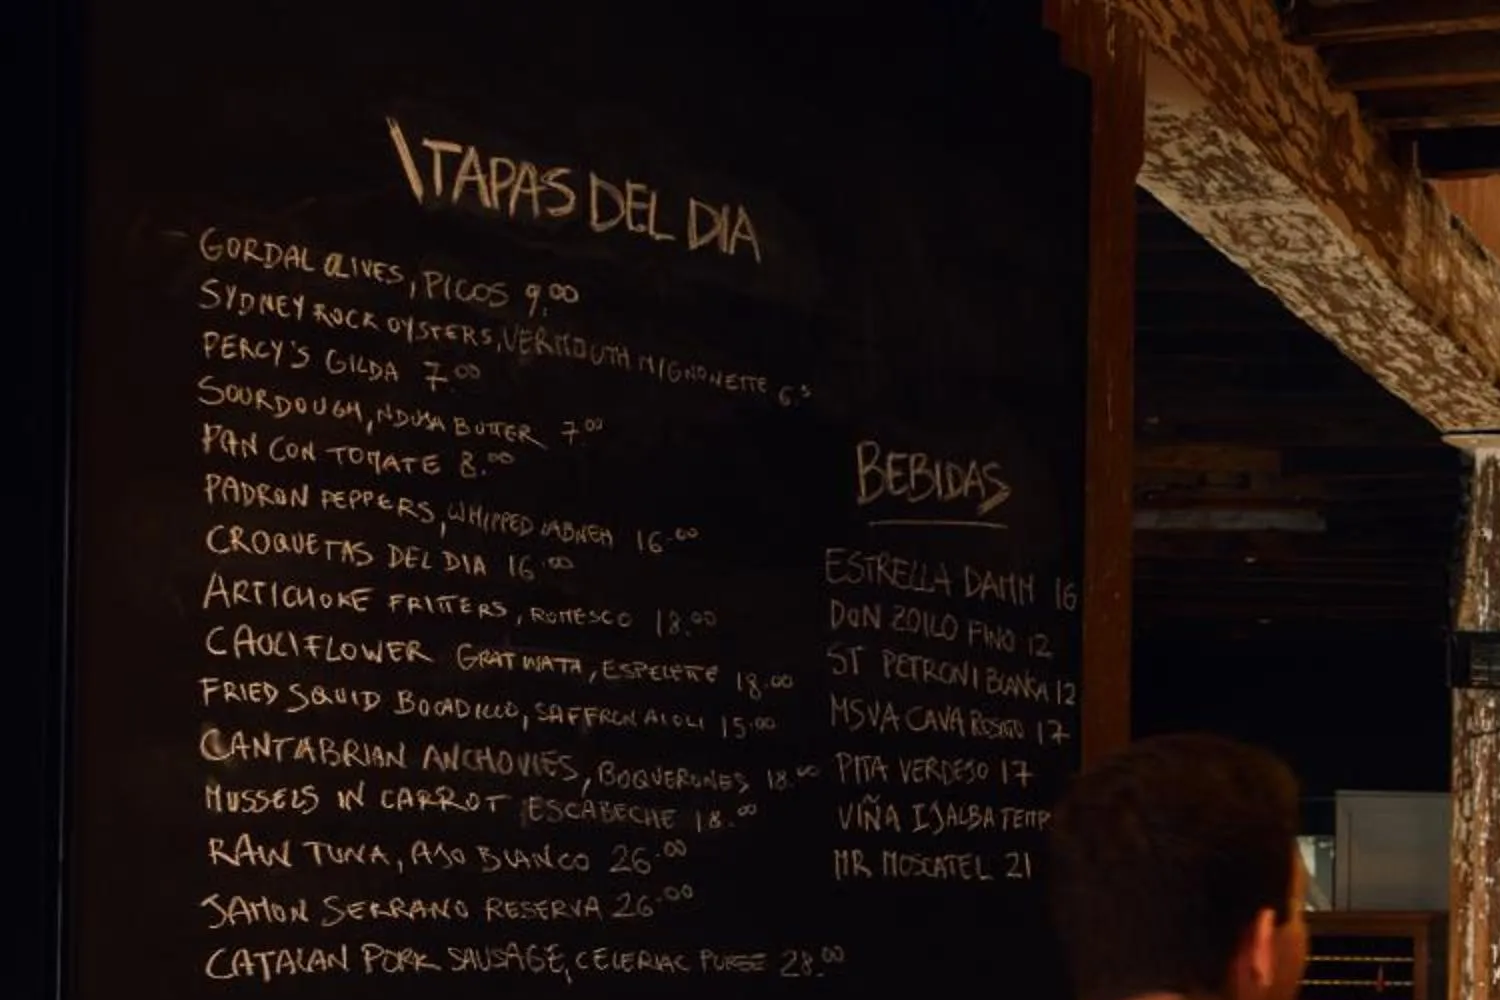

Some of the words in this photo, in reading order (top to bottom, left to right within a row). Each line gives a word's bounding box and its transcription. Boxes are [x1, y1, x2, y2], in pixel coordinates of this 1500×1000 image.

[588, 170, 676, 241] DEL
[688, 197, 762, 264] DIA
[199, 227, 316, 273] GORDAL
[422, 270, 510, 308] PICOS
[199, 278, 306, 321] SYDNEY
[312, 303, 381, 331] ROCK
[503, 327, 631, 371] VERMOUTH
[202, 331, 310, 369] PERCY'S
[325, 349, 399, 383] GILDA
[202, 422, 258, 457] PAN
[269, 435, 317, 463] CON
[325, 446, 441, 475] TOMATE
[453, 416, 549, 450] BUTTER
[856, 440, 1012, 516] BEBIDAS
[203, 473, 309, 508] PADRON
[448, 500, 534, 538] WHIPPED
[206, 524, 375, 568] CROQUETAS
[387, 543, 433, 570] DEL
[441, 550, 487, 577] DIA
[203, 571, 376, 614] ARTICHOKE
[530, 606, 633, 628] ROMESCO
[825, 547, 952, 596] ESTRELLA
[964, 565, 1035, 607] DAMM
[1055, 577, 1078, 611] 16
[206, 623, 435, 664] CAULIFLOWER
[830, 599, 881, 630] DON
[968, 620, 1015, 652] FINO
[1029, 634, 1054, 658] 12
[826, 645, 864, 676] ST
[881, 648, 979, 689] PETRONI
[1057, 680, 1076, 706] 12
[197, 677, 279, 707] FRIED
[285, 682, 381, 714] SQUID
[534, 702, 638, 729] SAFFRON
[643, 708, 705, 731] AIOLI
[905, 704, 966, 737] CAVA
[1038, 720, 1070, 746] 17
[199, 727, 408, 770] CANTABRIAN
[598, 760, 750, 794] BOQUERONES
[1001, 758, 1034, 788] 17
[204, 783, 320, 816] MUSSELS
[337, 780, 366, 811] IN
[381, 784, 513, 814] CARROT
[528, 795, 678, 830] ESCABECHE
[838, 794, 900, 833] VIÑA
[911, 800, 995, 835] IJALBA
[208, 833, 293, 868] RAW
[410, 839, 465, 869] AJO
[476, 843, 590, 873] BLANCO
[833, 848, 873, 881] MR
[882, 850, 995, 881] MOSCATEL
[1005, 851, 1032, 879] 21
[201, 893, 309, 929] JAMON
[321, 895, 469, 928] SERRANO
[484, 895, 601, 920] RESERVA
[205, 943, 350, 982] CATALAN
[360, 942, 442, 974] PORK
[575, 946, 692, 973] CELERIAC
